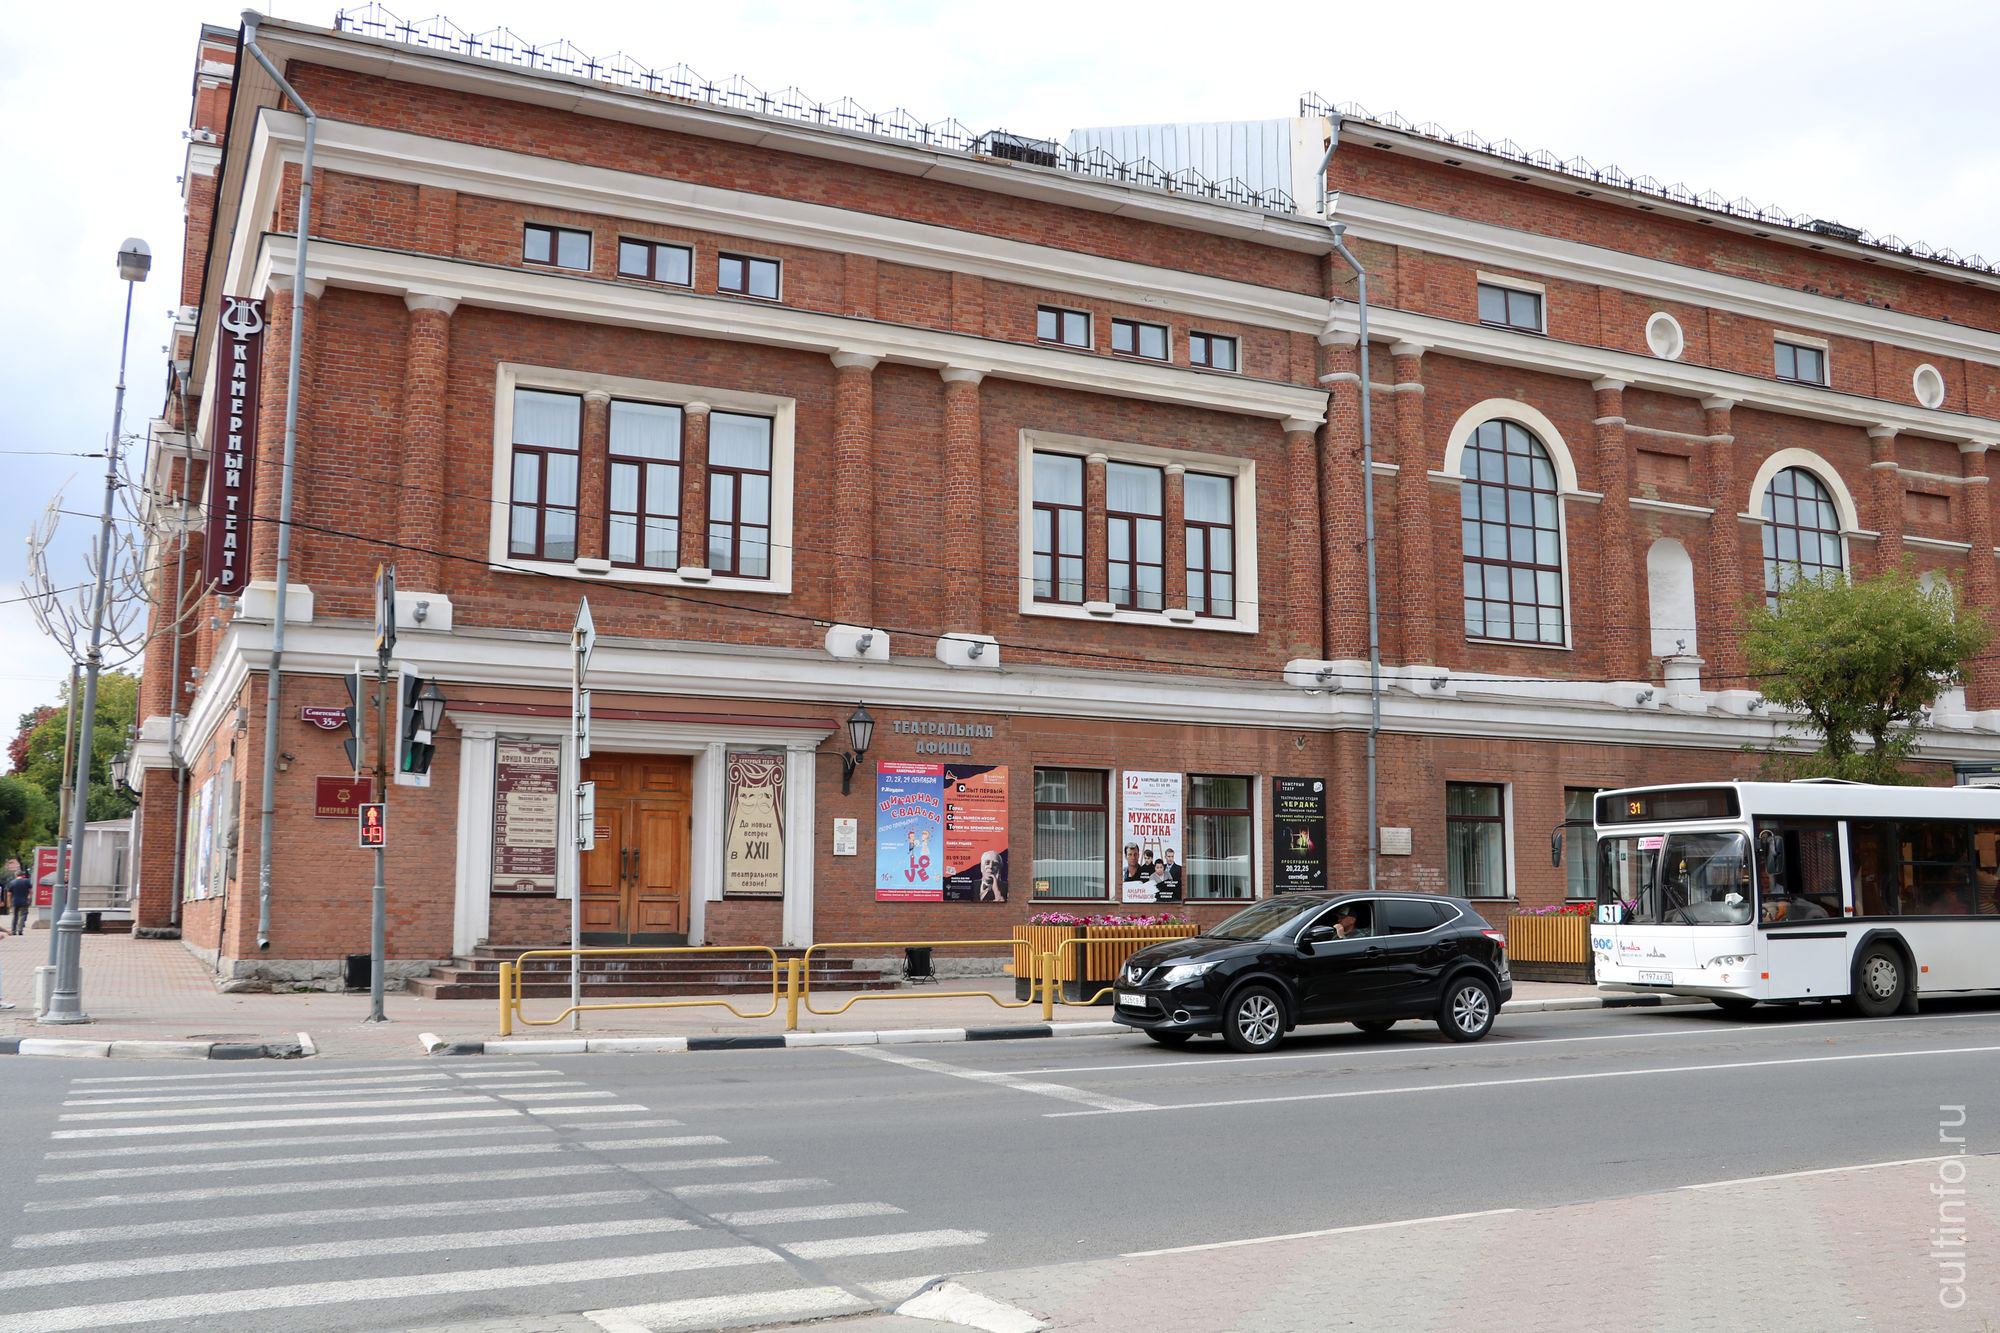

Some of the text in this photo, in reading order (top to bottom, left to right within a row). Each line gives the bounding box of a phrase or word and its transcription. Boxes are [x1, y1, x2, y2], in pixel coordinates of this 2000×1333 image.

[221, 344, 247, 586] КАМЕРНЫЙ ТЕАТР
[893, 720, 993, 738] ТЕАТРАЛЬНАЯ
[916, 741, 972, 756] АФИША
[532, 756, 556, 764] СЕНТЯБРЬ
[1126, 776, 1138, 789] 12
[880, 792, 940, 812] ШИКАРНАЯ
[1630, 802, 1640, 814] 31
[891, 806, 942, 824] СВАДЬБА
[1128, 812, 1176, 824] МУЖСКАЯ
[739, 820, 750, 828] До
[1133, 825, 1171, 836] ЛОГИКА
[362, 826, 382, 842] 49
[745, 841, 769, 860] XXII
[742, 878, 767, 887] сезоне!
[1603, 905, 1616, 922] 31
